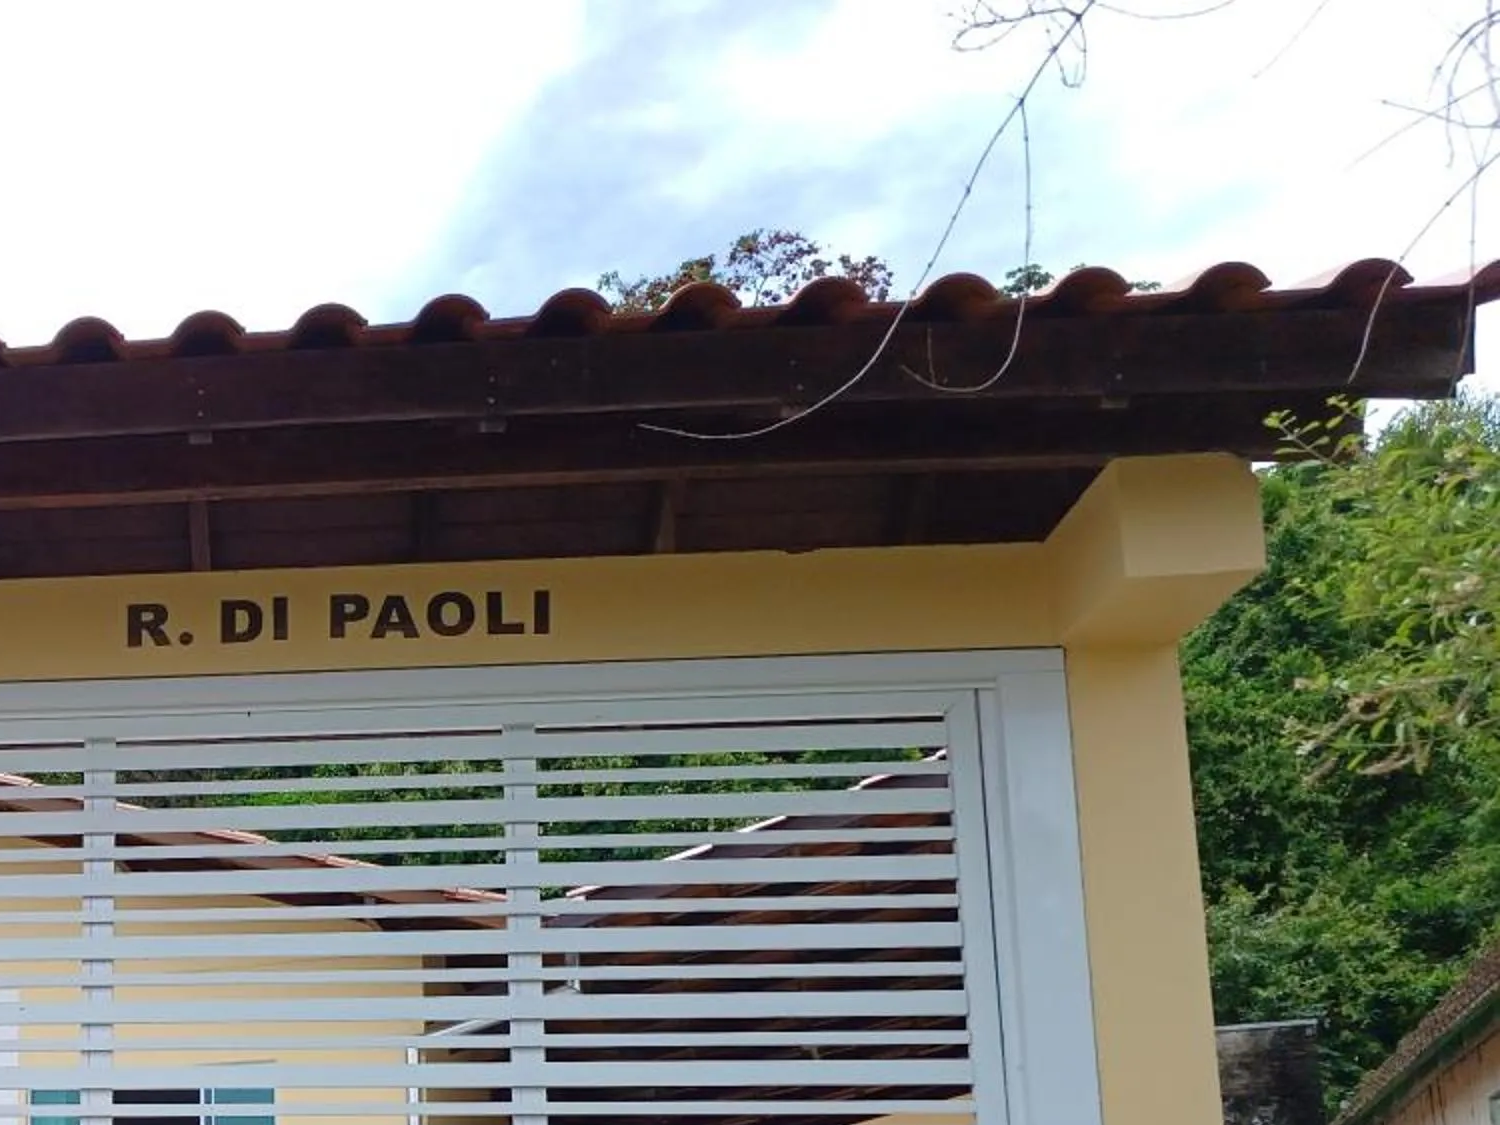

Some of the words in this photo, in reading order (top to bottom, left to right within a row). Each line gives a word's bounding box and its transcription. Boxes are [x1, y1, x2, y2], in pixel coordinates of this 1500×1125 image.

[127, 603, 194, 648] R.
[220, 597, 288, 644] DI
[330, 590, 550, 640] PAOLI
